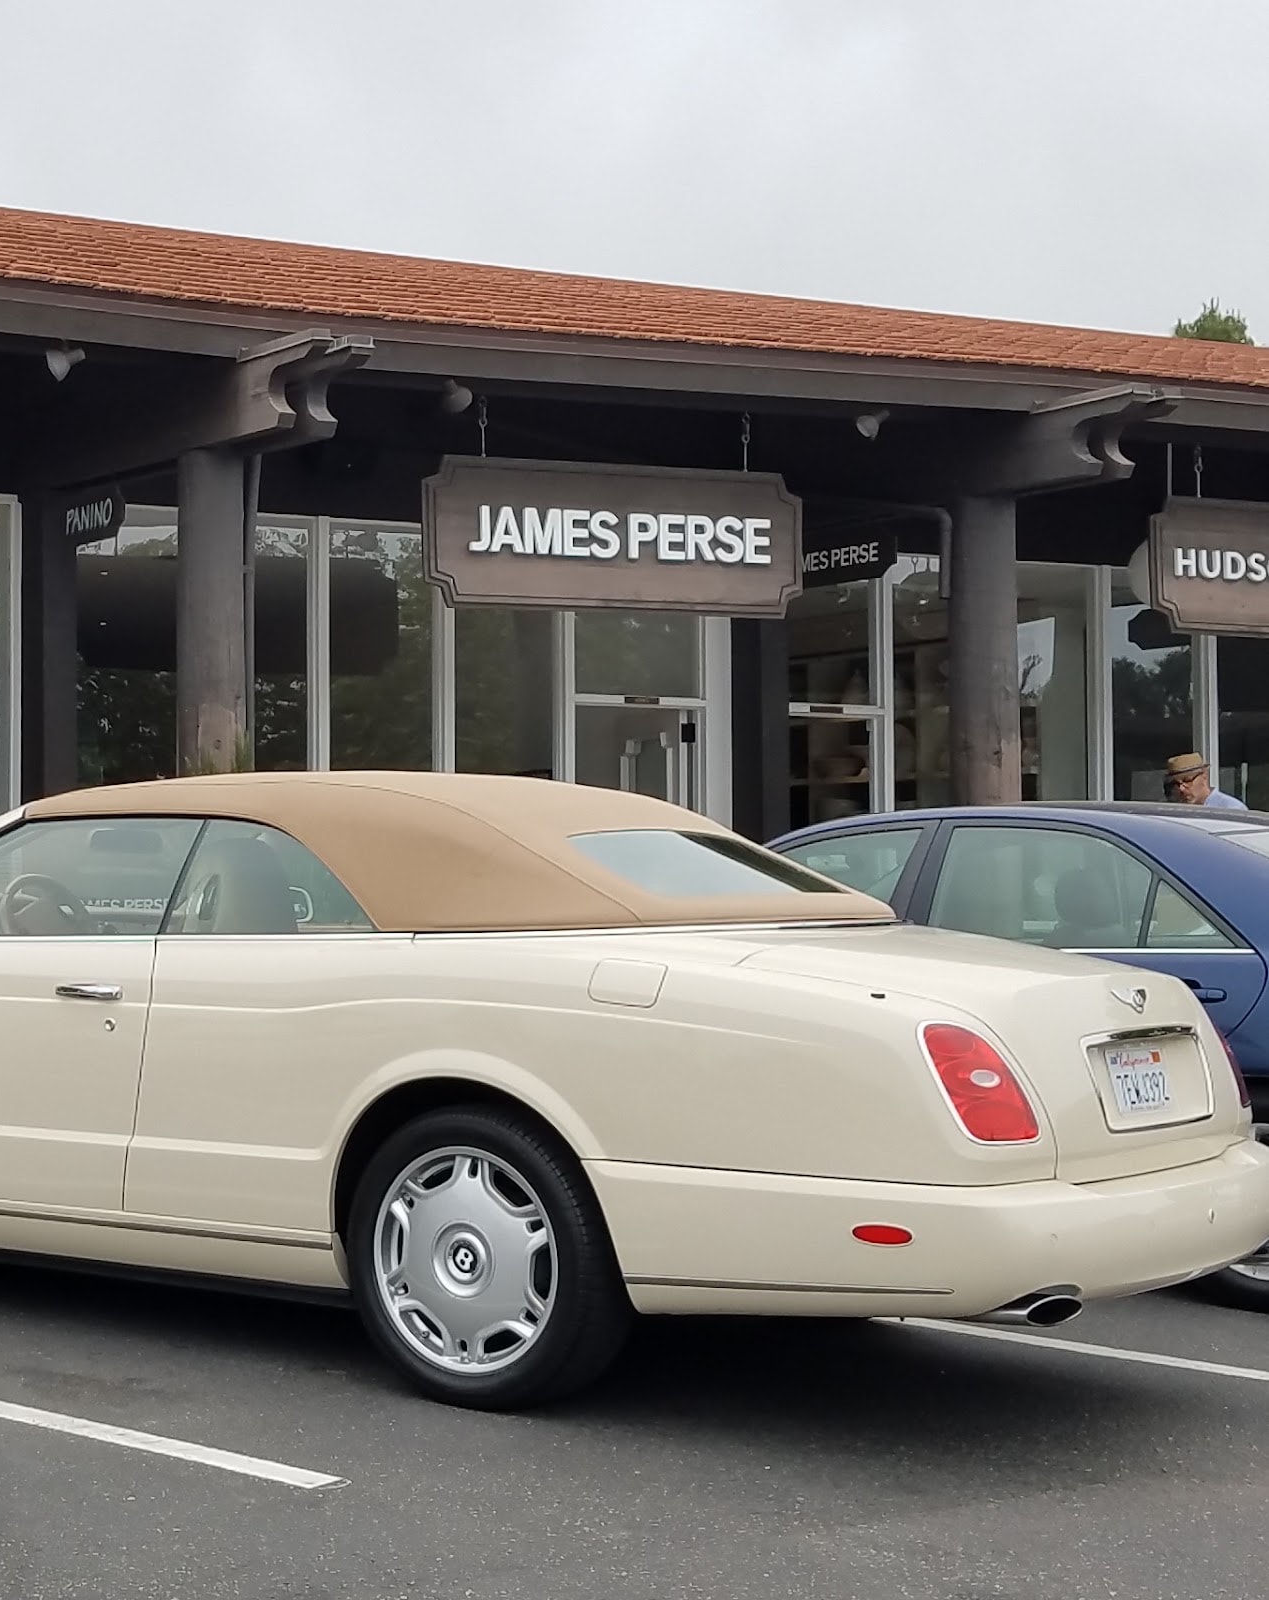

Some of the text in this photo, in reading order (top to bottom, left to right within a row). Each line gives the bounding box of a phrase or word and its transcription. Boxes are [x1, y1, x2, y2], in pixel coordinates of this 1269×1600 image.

[65, 497, 113, 536] PANINO
[468, 504, 772, 565] JAMES PERSE
[802, 541, 879, 573] MES PERSE
[1173, 547, 1269, 582] HUDS
